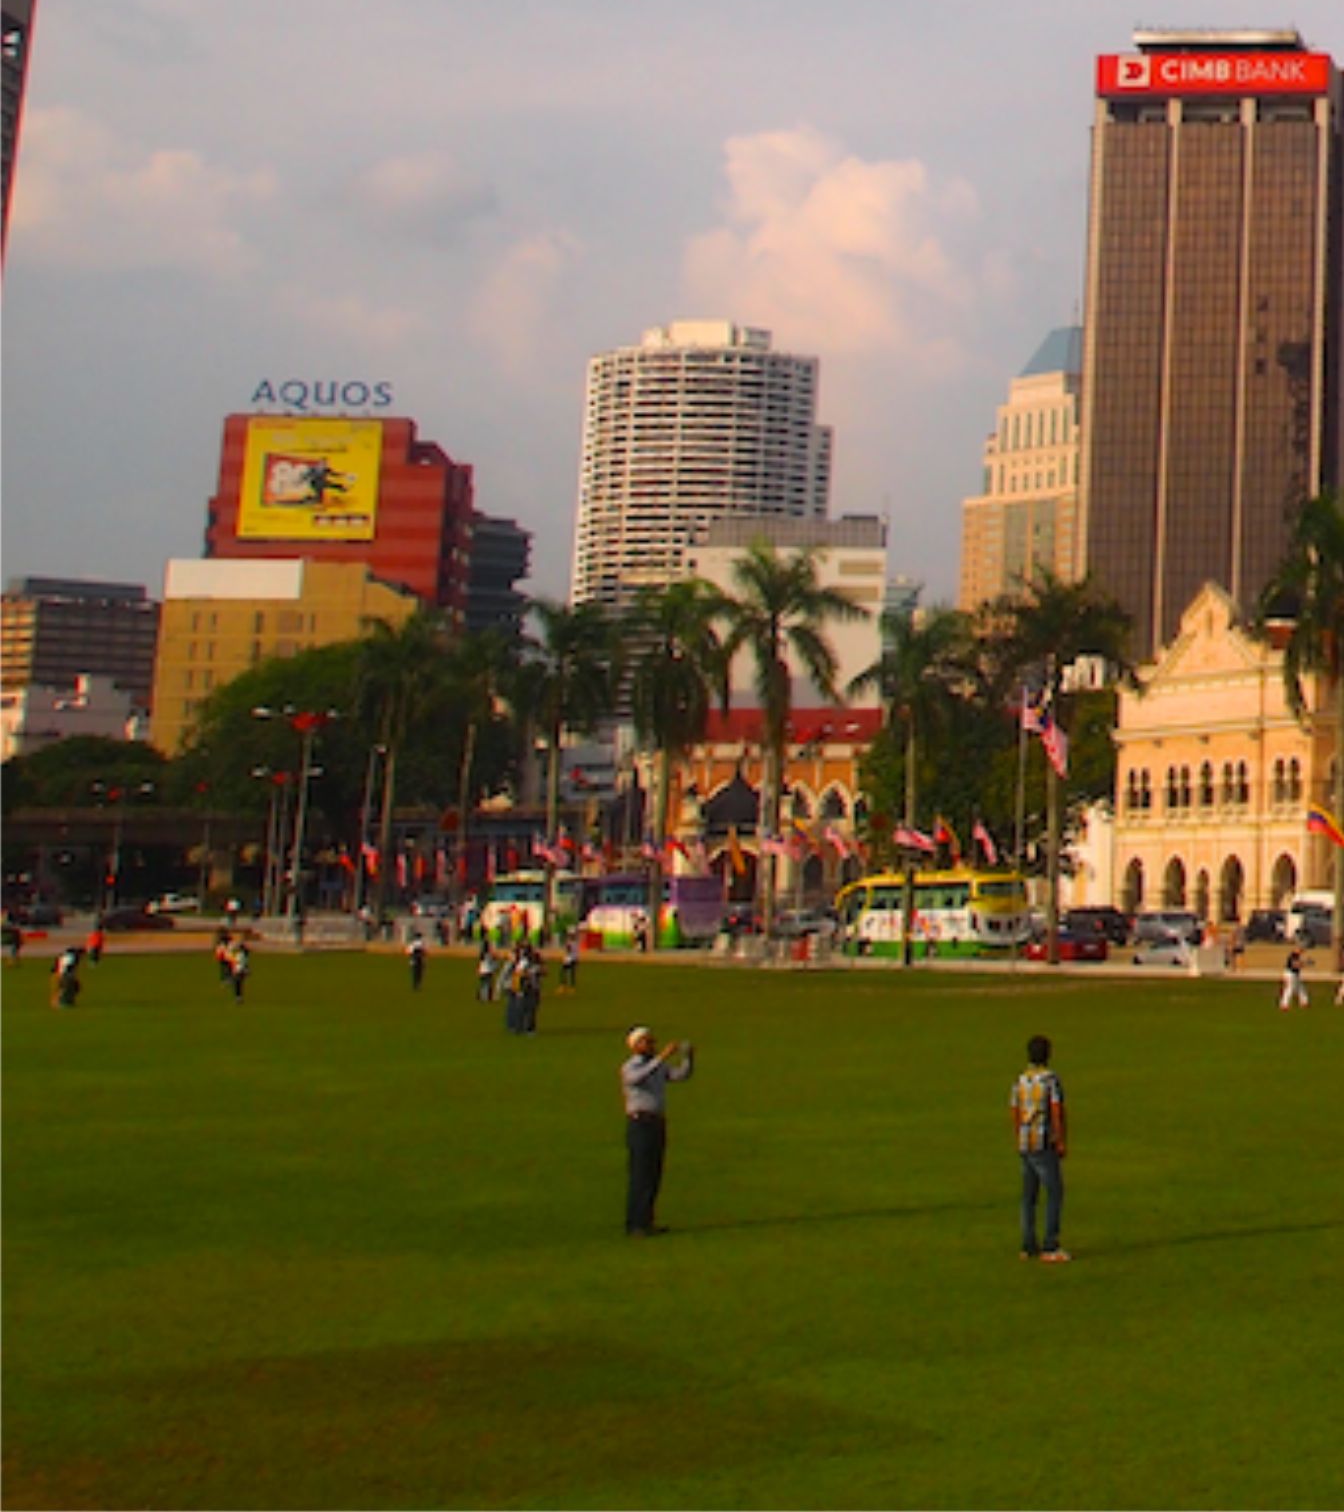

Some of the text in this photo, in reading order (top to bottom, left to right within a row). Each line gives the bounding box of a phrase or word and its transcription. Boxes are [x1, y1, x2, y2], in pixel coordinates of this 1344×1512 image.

[1160, 59, 1307, 81] CIMB BANK
[251, 378, 393, 409] AQUOS
